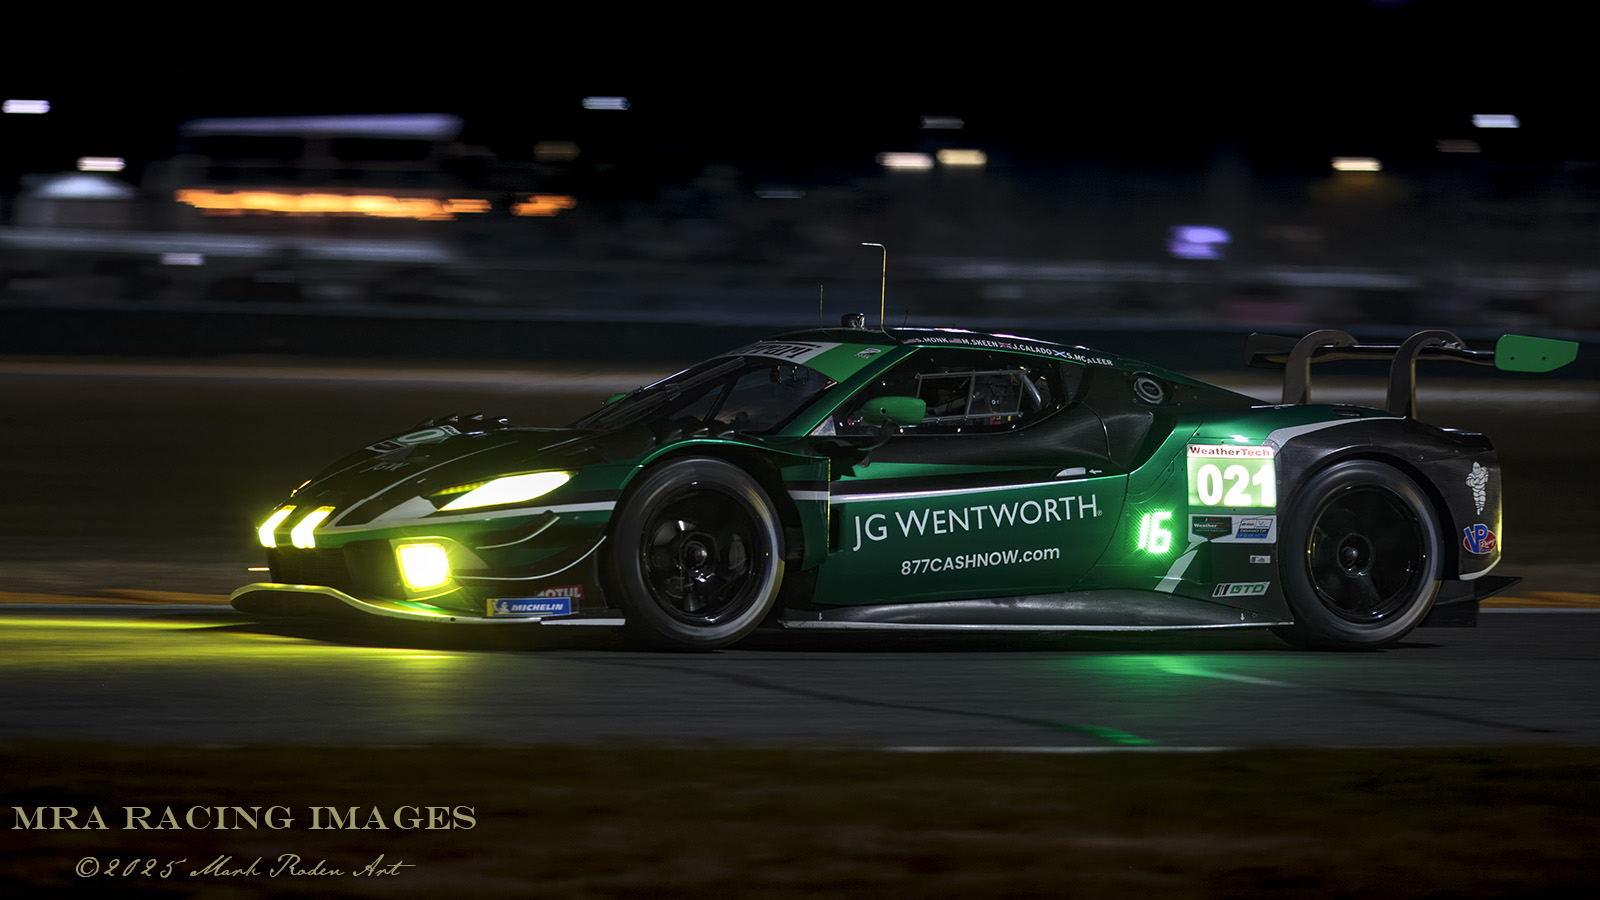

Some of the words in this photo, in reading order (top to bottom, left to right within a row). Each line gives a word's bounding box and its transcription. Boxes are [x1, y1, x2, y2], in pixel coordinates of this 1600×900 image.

[915, 336, 949, 344] S.MONK
[962, 339, 998, 347] M.SKEEN
[1012, 344, 1052, 355] J.CALADO
[1189, 446, 1270, 456] WeatherTech
[1197, 463, 1275, 507] 021
[853, 513, 888, 551] JG
[894, 494, 1097, 538] WENTWORTH
[1137, 511, 1173, 554] 16
[1463, 523, 1488, 554] VP
[901, 547, 1060, 576] 877CASHNOW.com
[1230, 584, 1265, 594] GTD
[511, 603, 564, 612] MICHELIN
